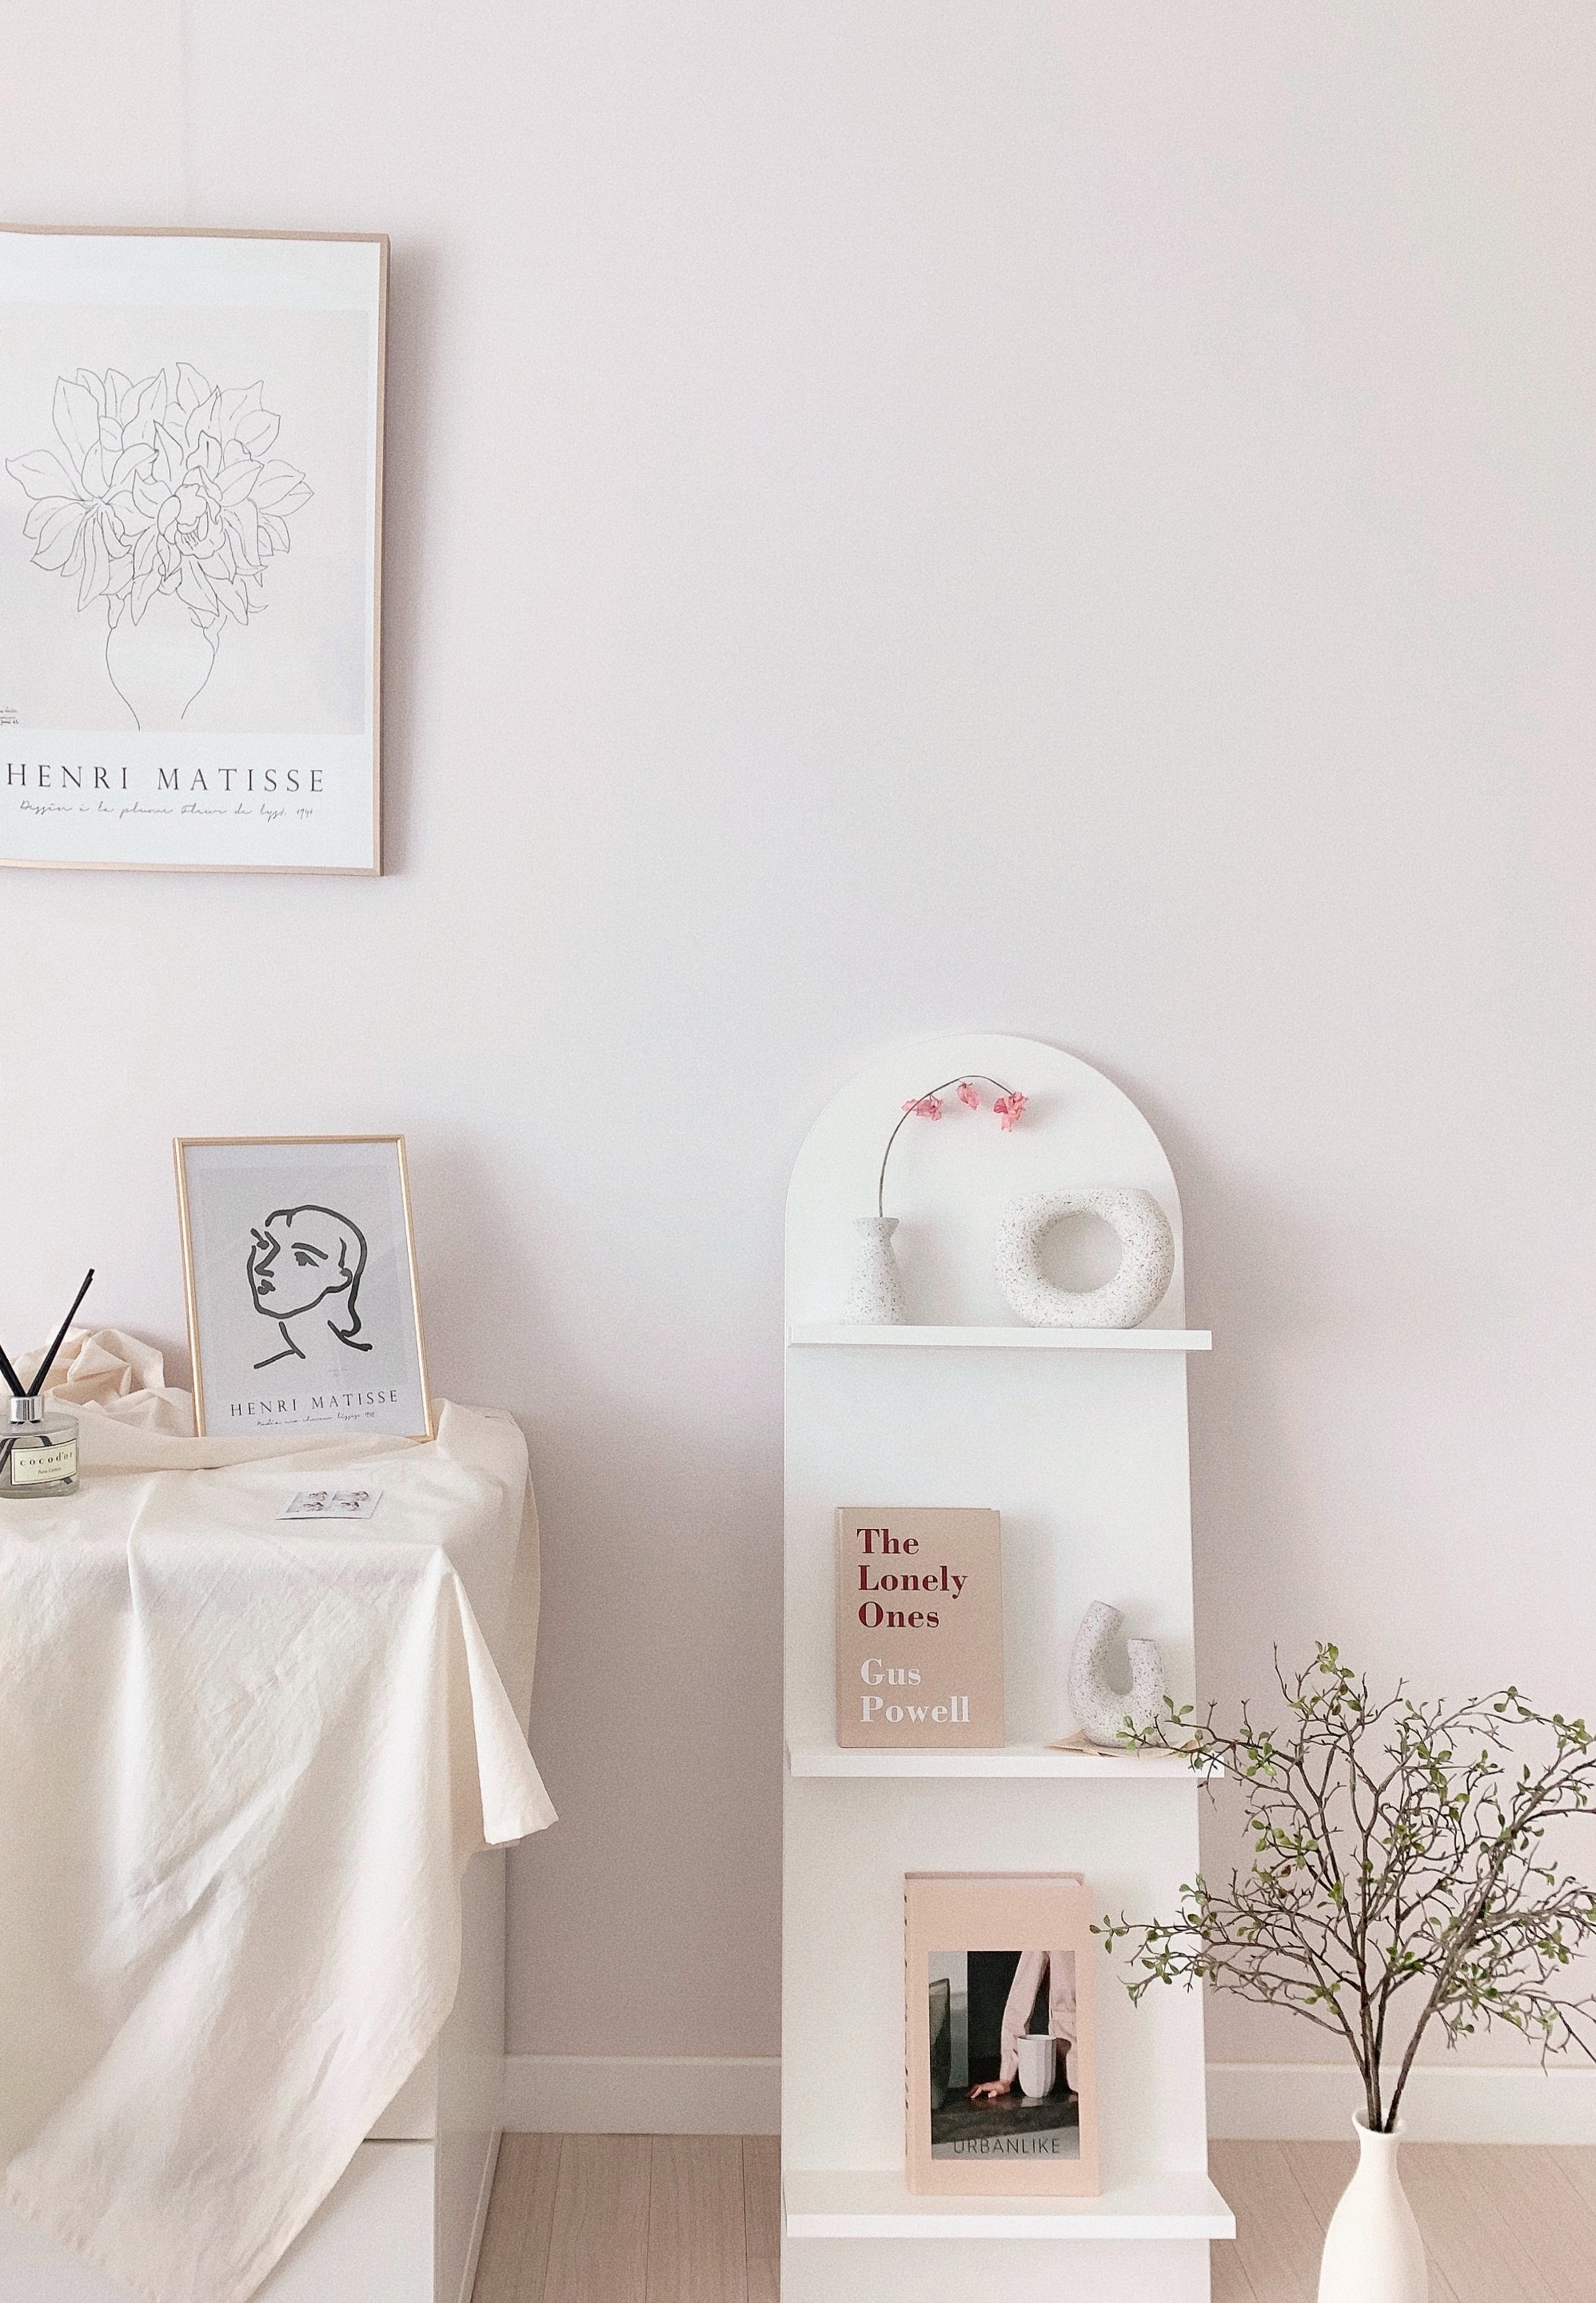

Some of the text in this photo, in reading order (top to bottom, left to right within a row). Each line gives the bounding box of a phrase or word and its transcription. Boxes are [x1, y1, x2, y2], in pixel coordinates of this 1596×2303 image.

[6, 762, 324, 792] HENRI MATISSE
[230, 1390, 398, 1417] HENRI MATISSE
[856, 1528, 920, 1555] The
[857, 1564, 968, 1599] Lonely
[858, 1601, 940, 1628] Ones
[860, 1658, 921, 1686] Gus
[860, 1695, 971, 1723] Powell
[953, 2136, 1060, 2154] URBANLIKE
